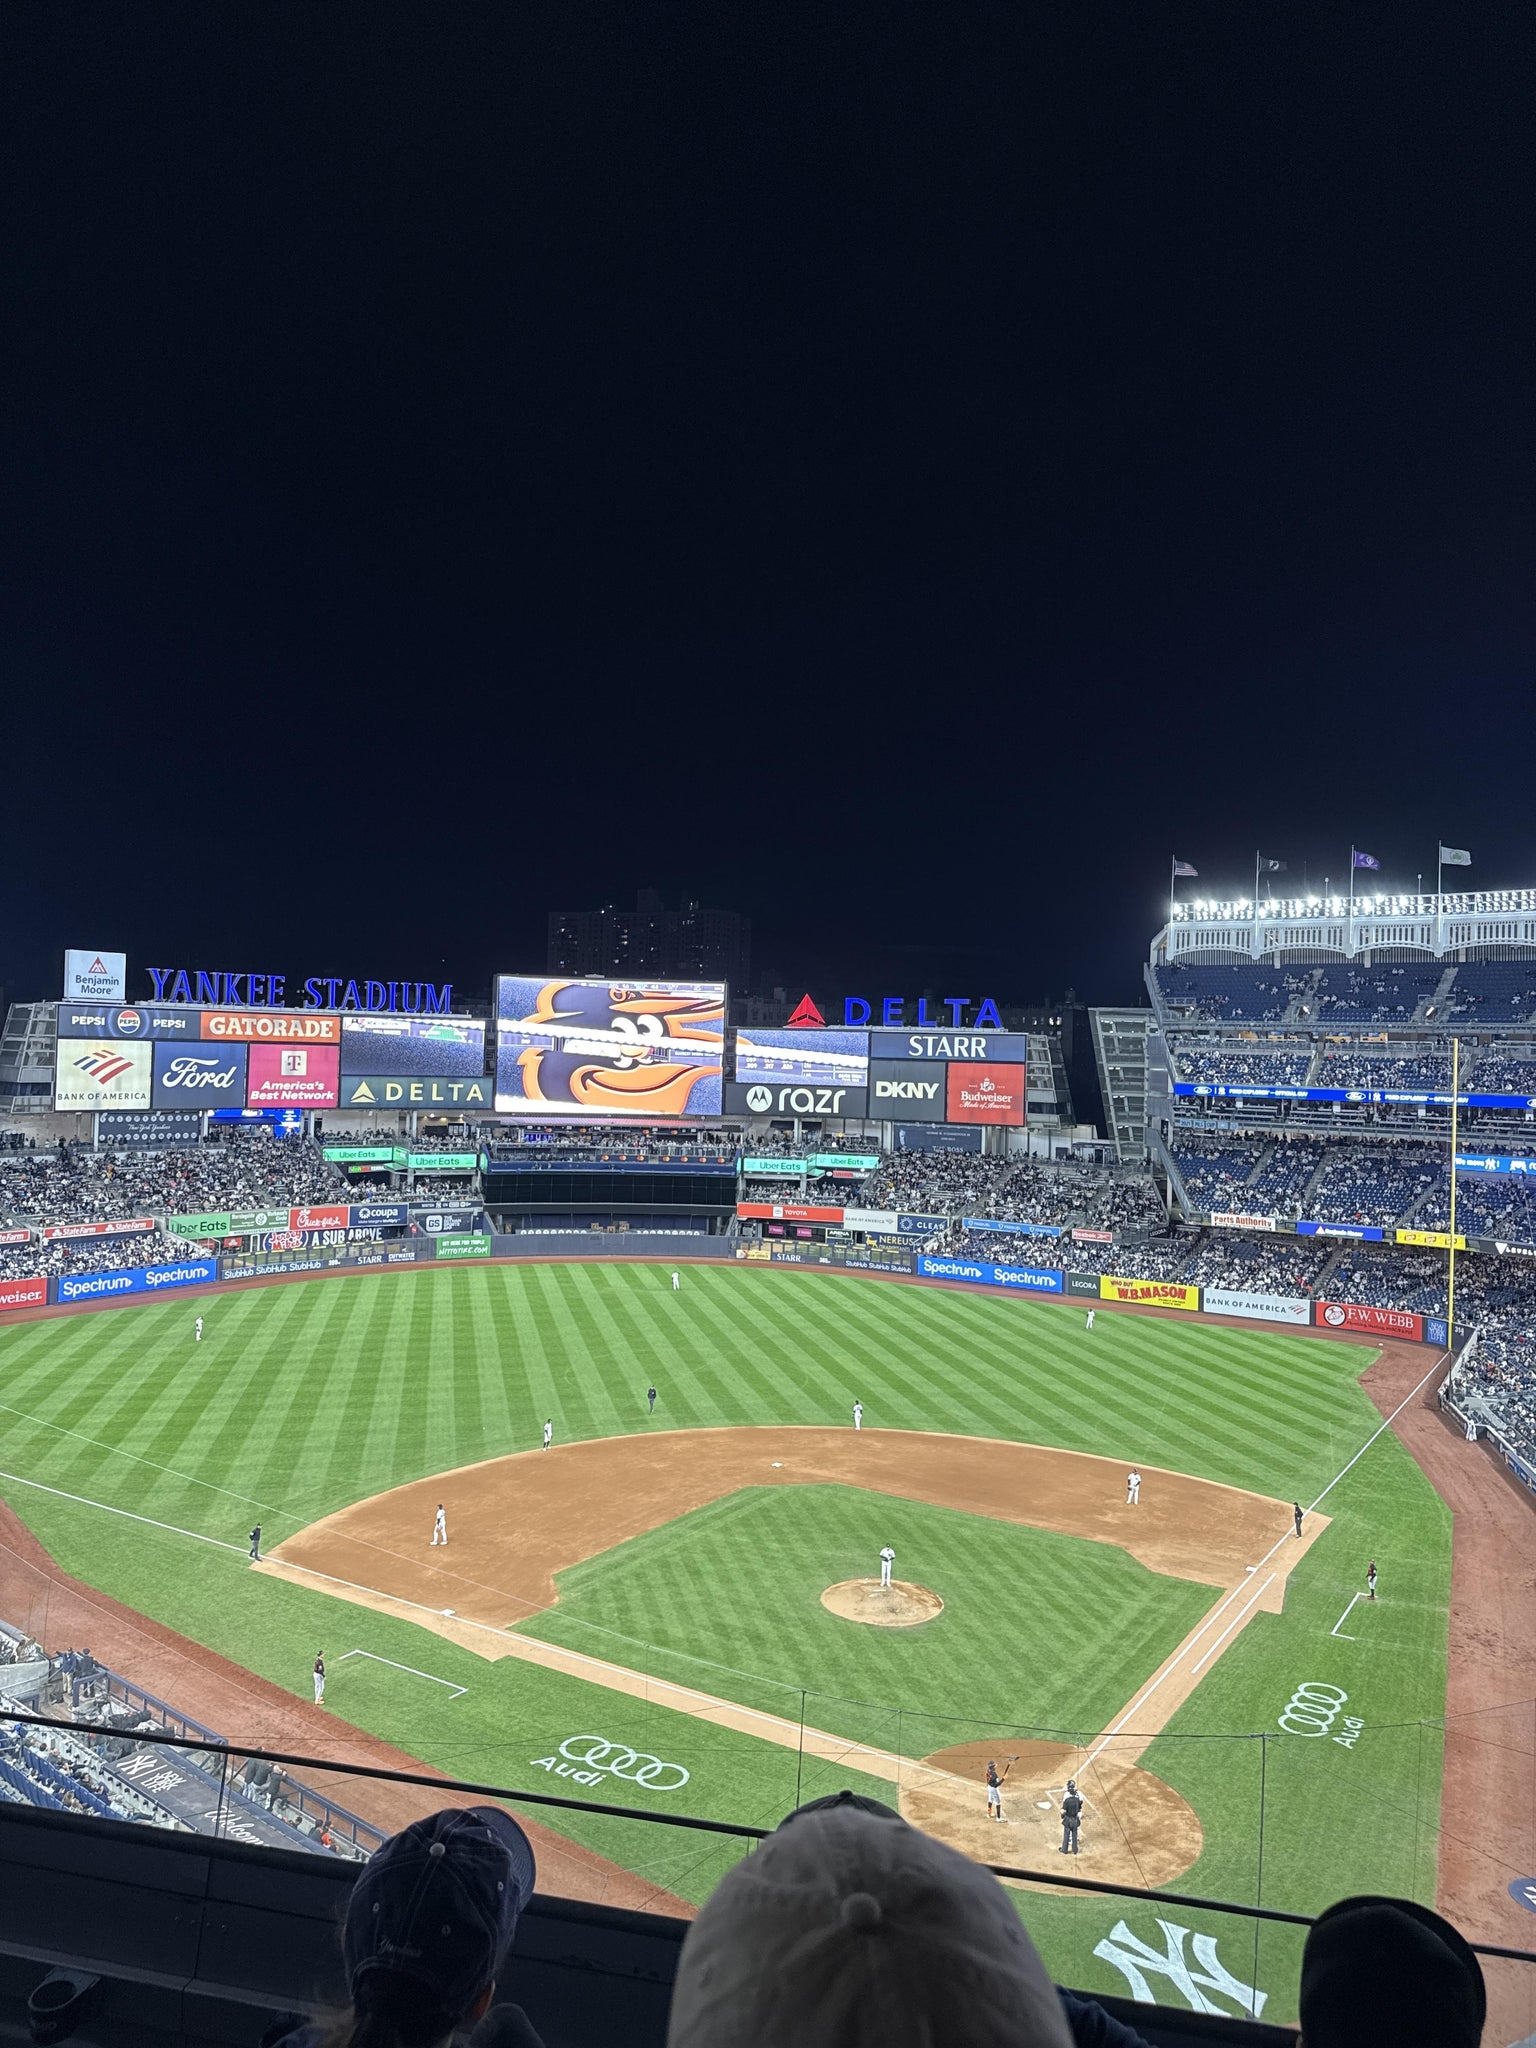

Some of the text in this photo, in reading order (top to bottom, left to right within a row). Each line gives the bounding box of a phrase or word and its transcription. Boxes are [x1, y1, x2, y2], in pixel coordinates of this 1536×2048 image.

[75, 974, 119, 987] Benjamin
[80, 985, 112, 995] Moore
[145, 967, 454, 1014] YANKEE STADIUM
[844, 997, 1004, 1029] DELTA
[71, 1015, 106, 1026] PEPSI
[119, 1018, 139, 1026] PEPSI
[152, 1018, 186, 1028] PEPSI
[209, 1017, 333, 1038] GATORADE
[908, 1035, 987, 1058] STARR
[162, 1057, 237, 1088] Ford
[261, 1081, 325, 1091] America's
[385, 1083, 484, 1102] DELTA
[875, 1080, 940, 1099] DKNY
[57, 1092, 147, 1101] BANK OF AMERICA
[250, 1090, 335, 1101] Best Network
[778, 1088, 846, 1113] razr
[960, 1090, 1013, 1103] Budweiser
[415, 1158, 460, 1166] Uber Eats
[760, 1161, 801, 1171] Uber Eats
[847, 1158, 864, 1166] Eats
[371, 1208, 399, 1219] coupa
[171, 1223, 198, 1234] Uber
[200, 1221, 227, 1232] Eats
[916, 1221, 945, 1230] CLEAR
[1214, 1215, 1234, 1224] Parts
[1235, 1216, 1272, 1227] Authority
[311, 1227, 382, 1246] A SUB ABOVE
[879, 1235, 914, 1246] NEREUS
[357, 1255, 382, 1265] STARR
[776, 1253, 801, 1263] STARR
[224, 1261, 322, 1279] StubHub StubHub StubHub
[845, 1260, 912, 1273] StubHub StubHub StubHub
[923, 1260, 978, 1278] Spectrum
[145, 1267, 204, 1287] Spectrum
[993, 1268, 1051, 1286] Spectrum
[64, 1277, 128, 1298] Spectrum
[1071, 1281, 1097, 1290] LEGORA
[1205, 1298, 1230, 1306] BANK
[1245, 1302, 1287, 1314] AMERICA
[1348, 1308, 1414, 1329] F.W. WEBB
[1332, 1715, 1365, 1750] Audi
[530, 1756, 607, 1787] Audi
[204, 1805, 270, 1847] Welcom
[1092, 1918, 1268, 2019] NY
